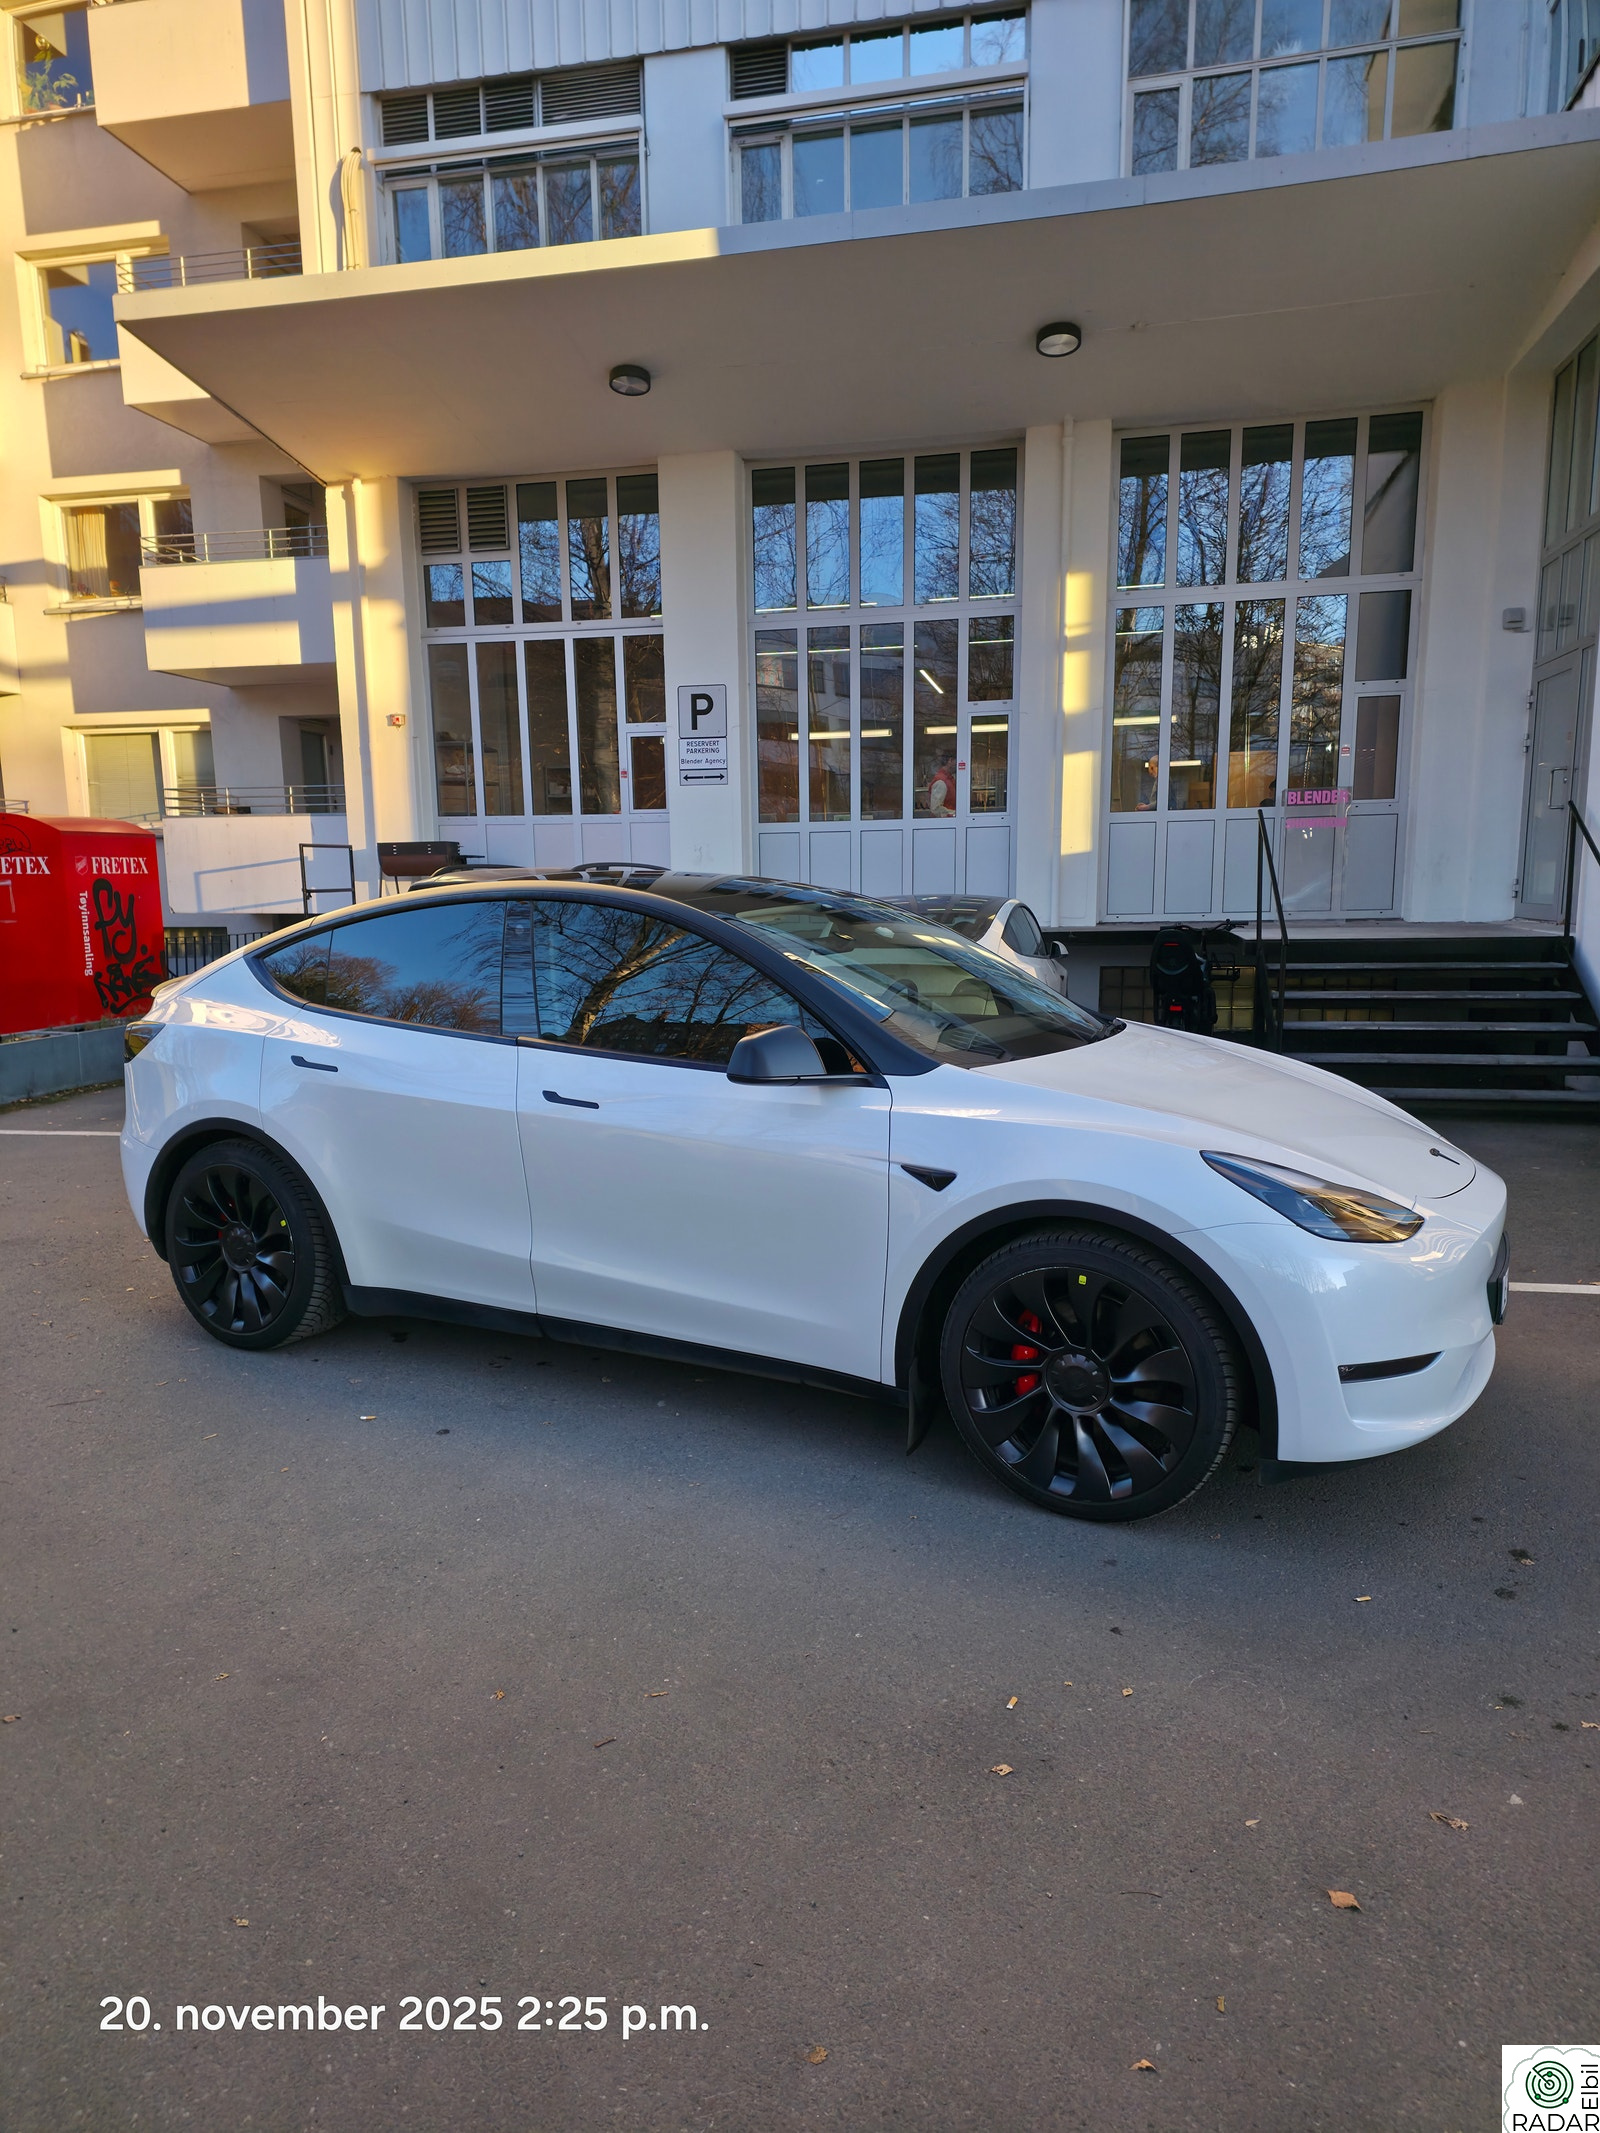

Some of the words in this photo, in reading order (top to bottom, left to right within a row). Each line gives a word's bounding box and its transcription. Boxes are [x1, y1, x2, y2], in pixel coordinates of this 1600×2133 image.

[691, 693, 714, 730] P
[686, 740, 720, 748] RESERVERT
[704, 757, 726, 765] Agency
[1287, 789, 1349, 805] BLENDER
[92, 857, 148, 874] FRETEX
[79, 890, 93, 976] Tøyinnsamling
